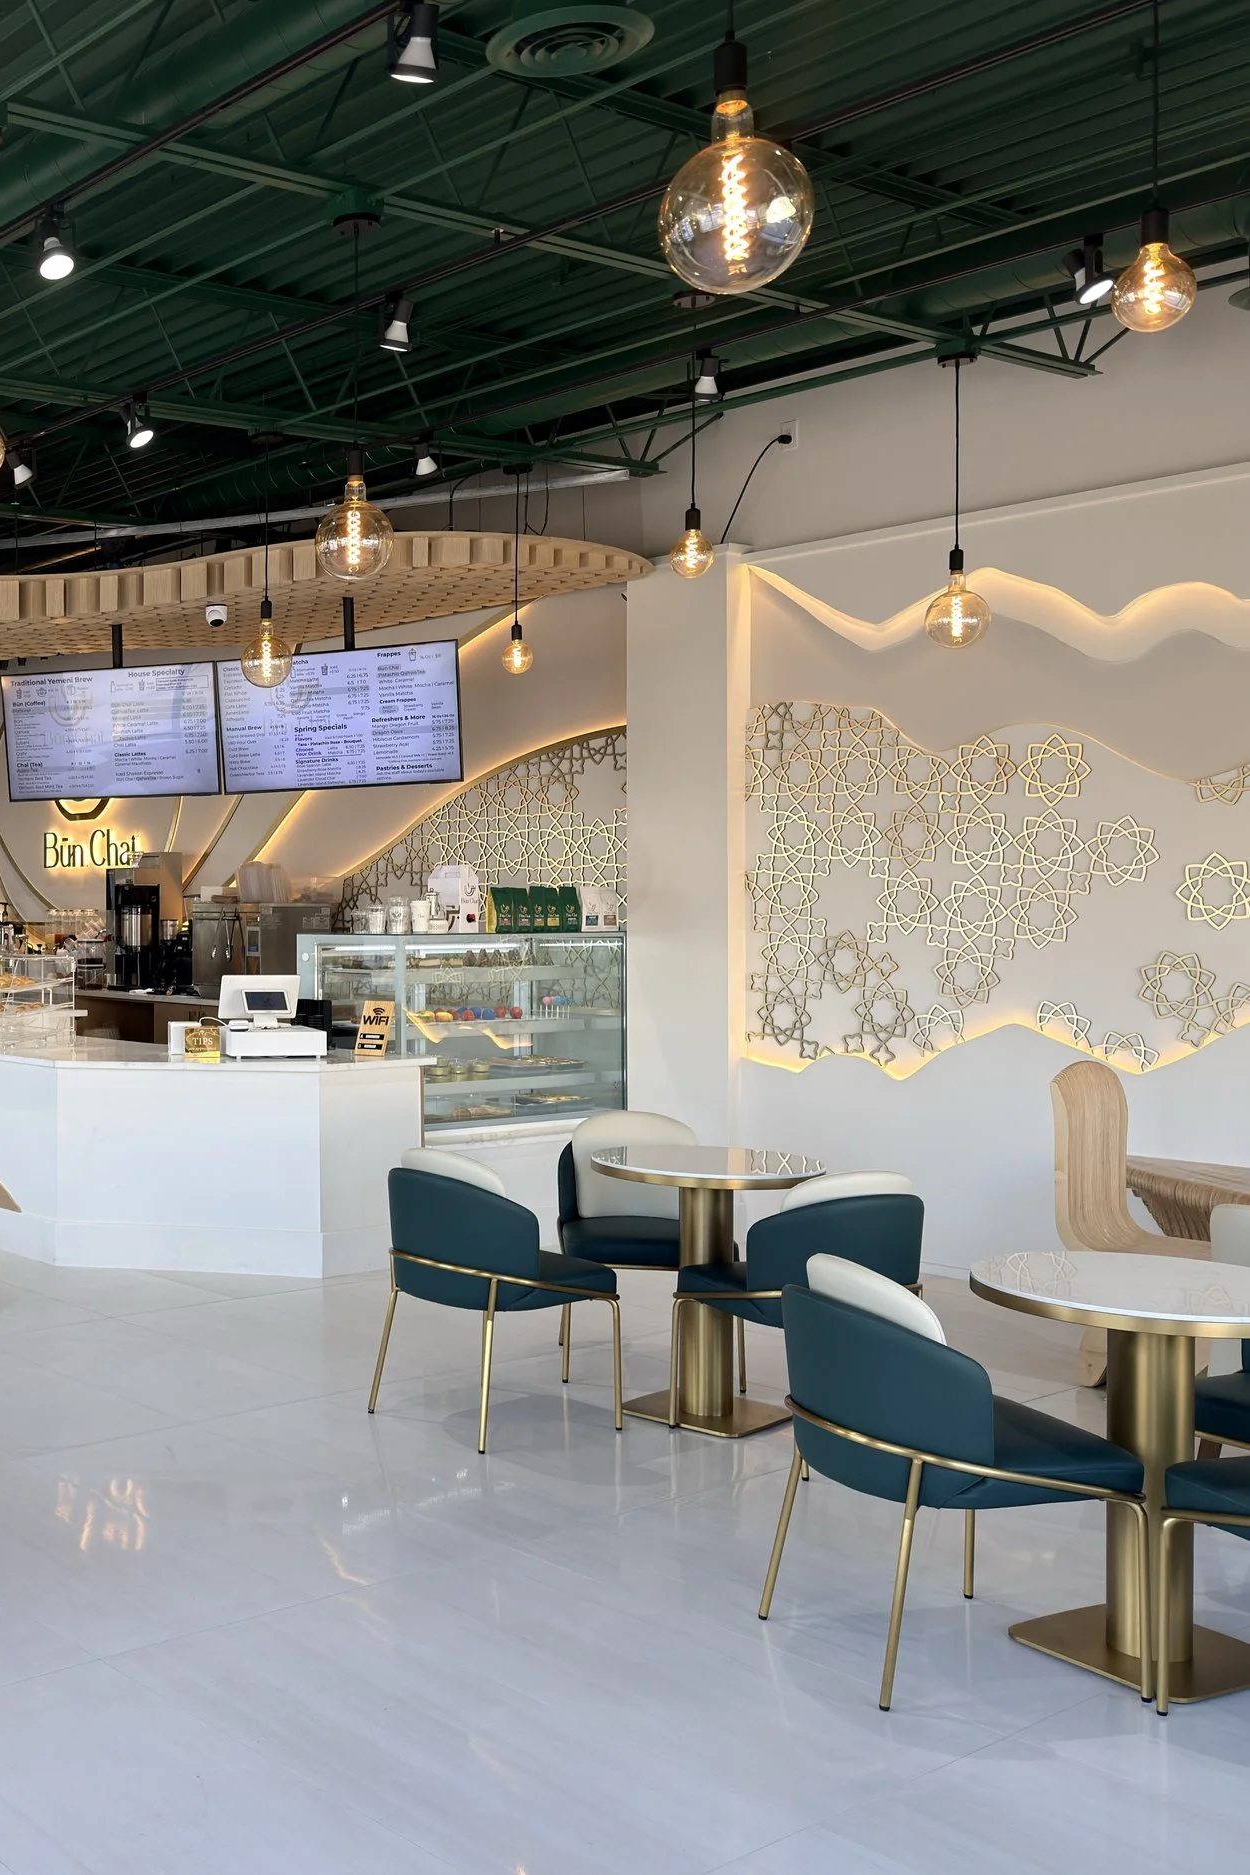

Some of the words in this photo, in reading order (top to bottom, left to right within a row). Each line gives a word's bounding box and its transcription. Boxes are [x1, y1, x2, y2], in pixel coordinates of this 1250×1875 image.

[152, 668, 186, 677] Specialty
[12, 678, 47, 687] Traditional
[48, 676, 74, 685] Yemeni
[294, 726, 317, 734] Spring
[318, 724, 348, 732] Specials
[192, 1037, 213, 1046] TIPS
